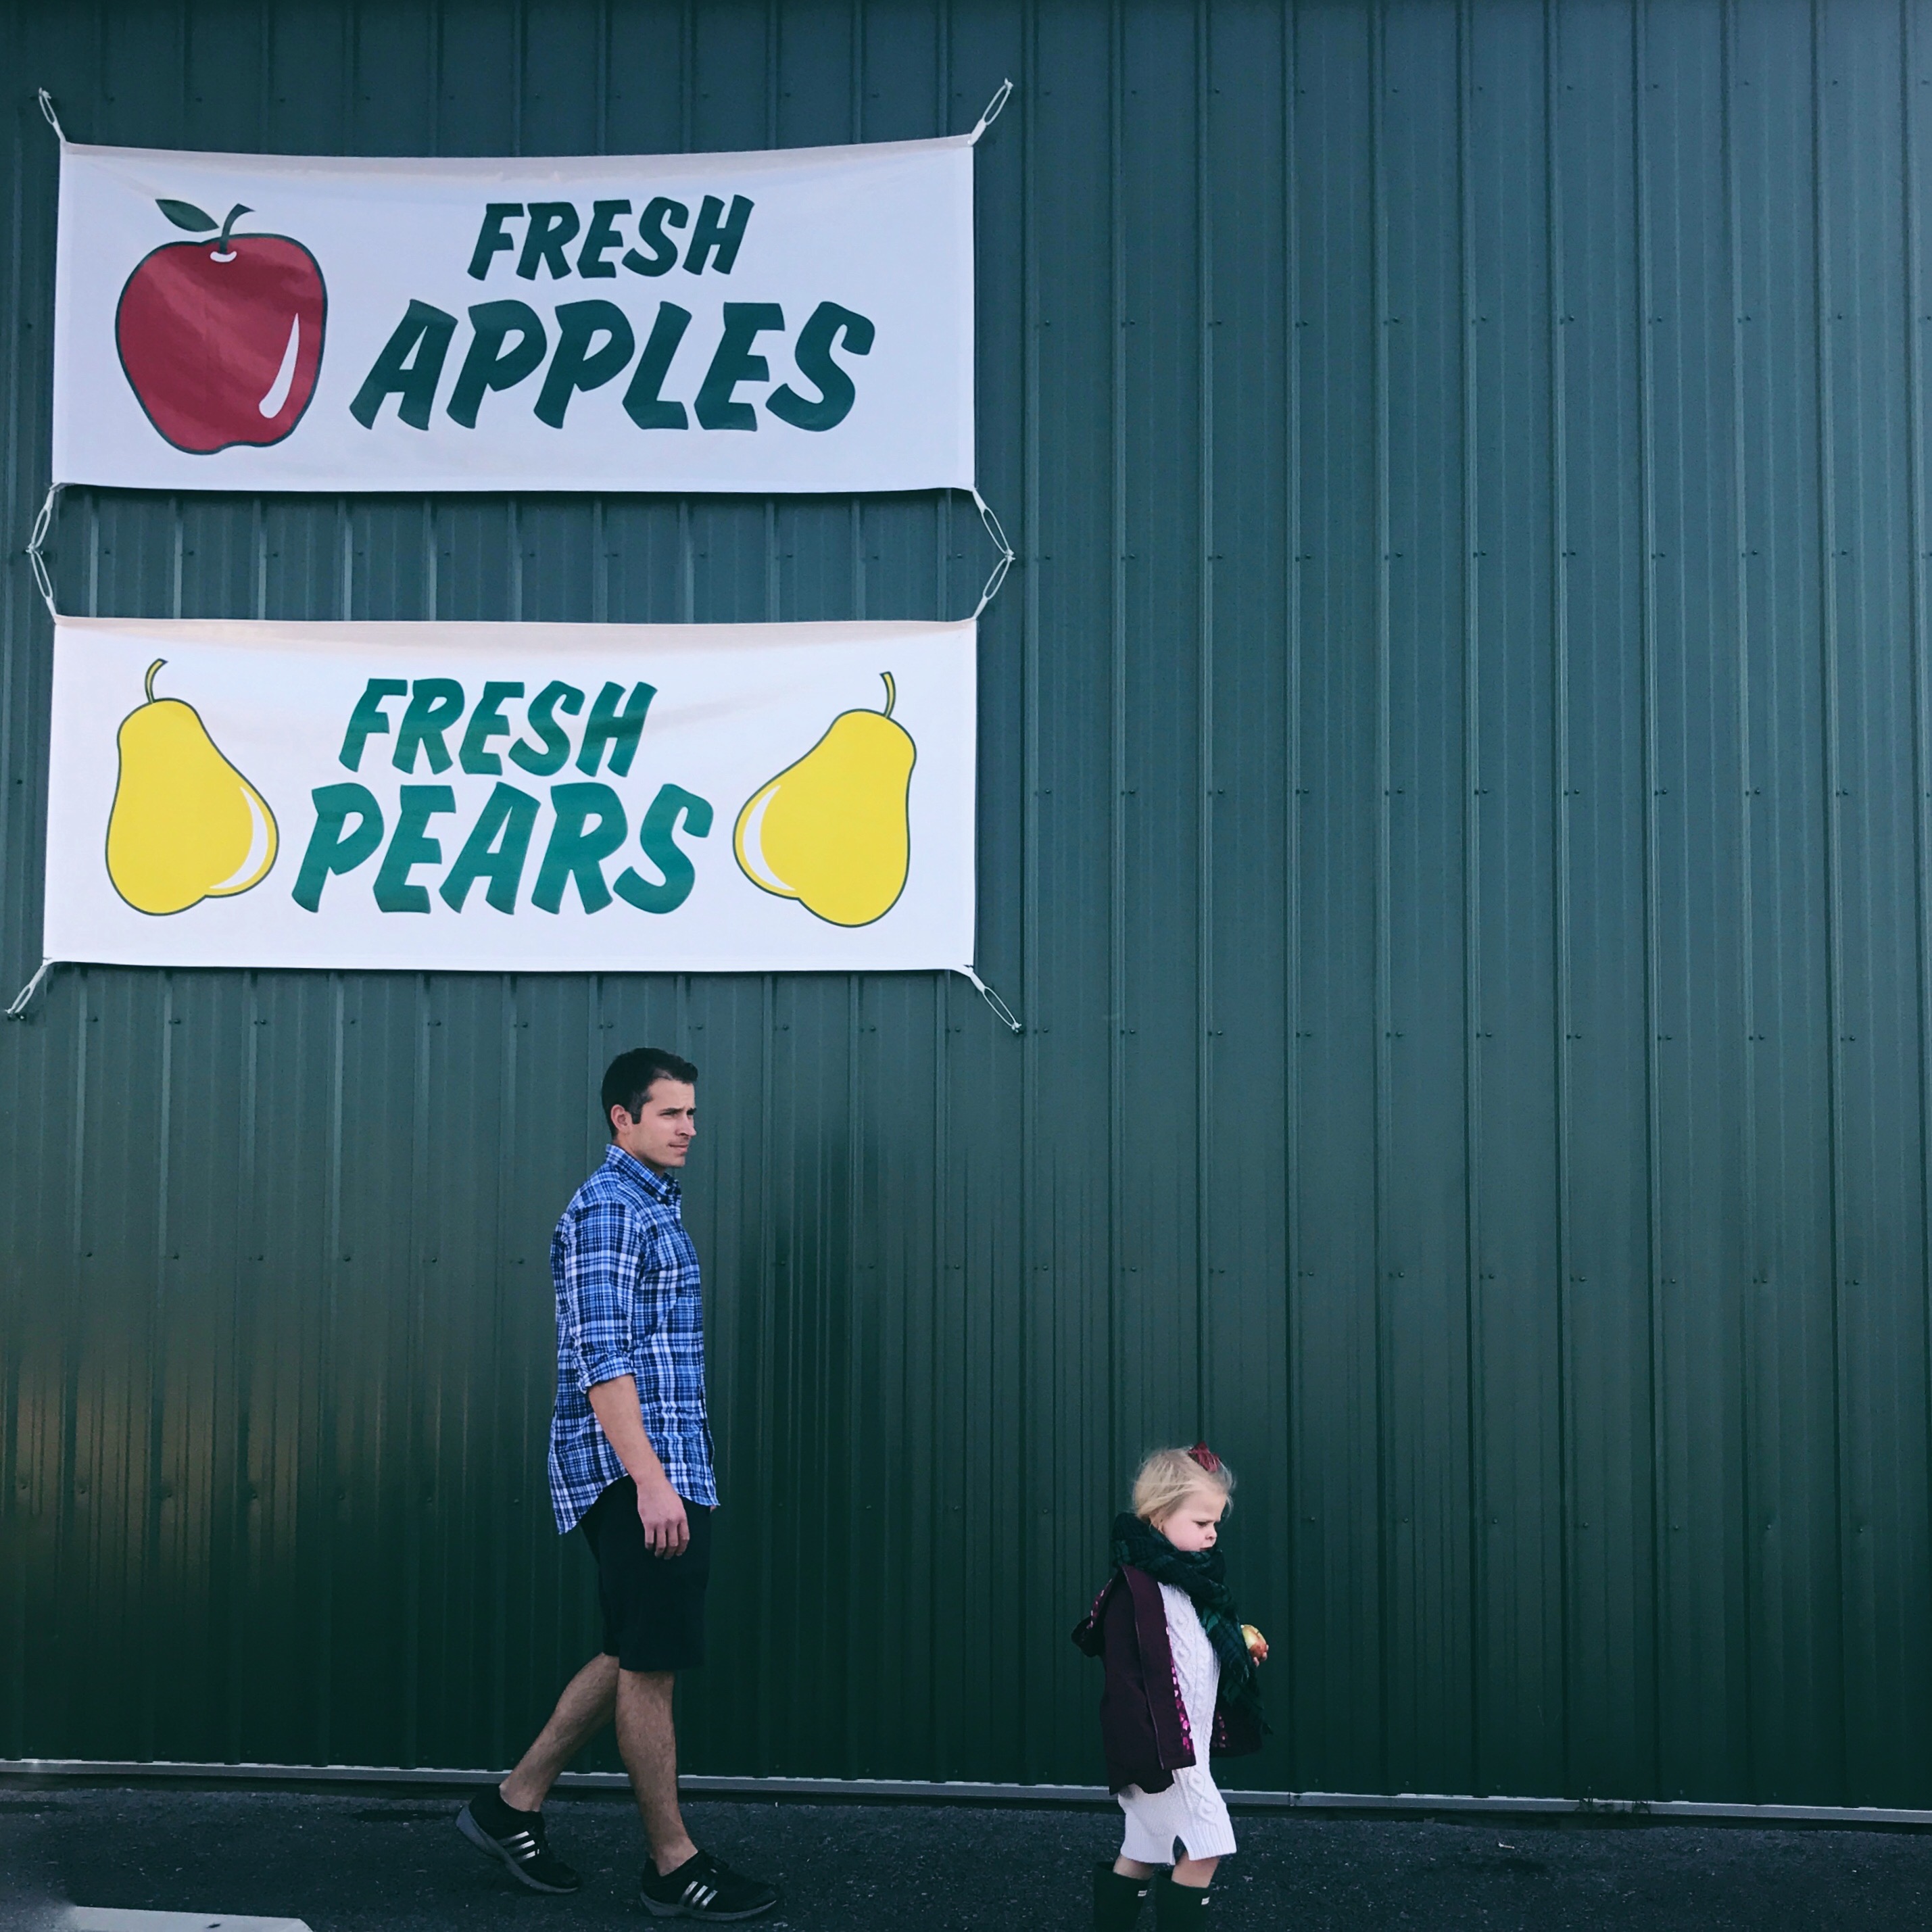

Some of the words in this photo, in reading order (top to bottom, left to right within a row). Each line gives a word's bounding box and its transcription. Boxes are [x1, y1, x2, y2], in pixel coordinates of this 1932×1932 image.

[467, 195, 754, 281] FRESH
[349, 299, 875, 432] APPLES
[339, 678, 657, 777] FRESH
[292, 782, 713, 915] PEARS
